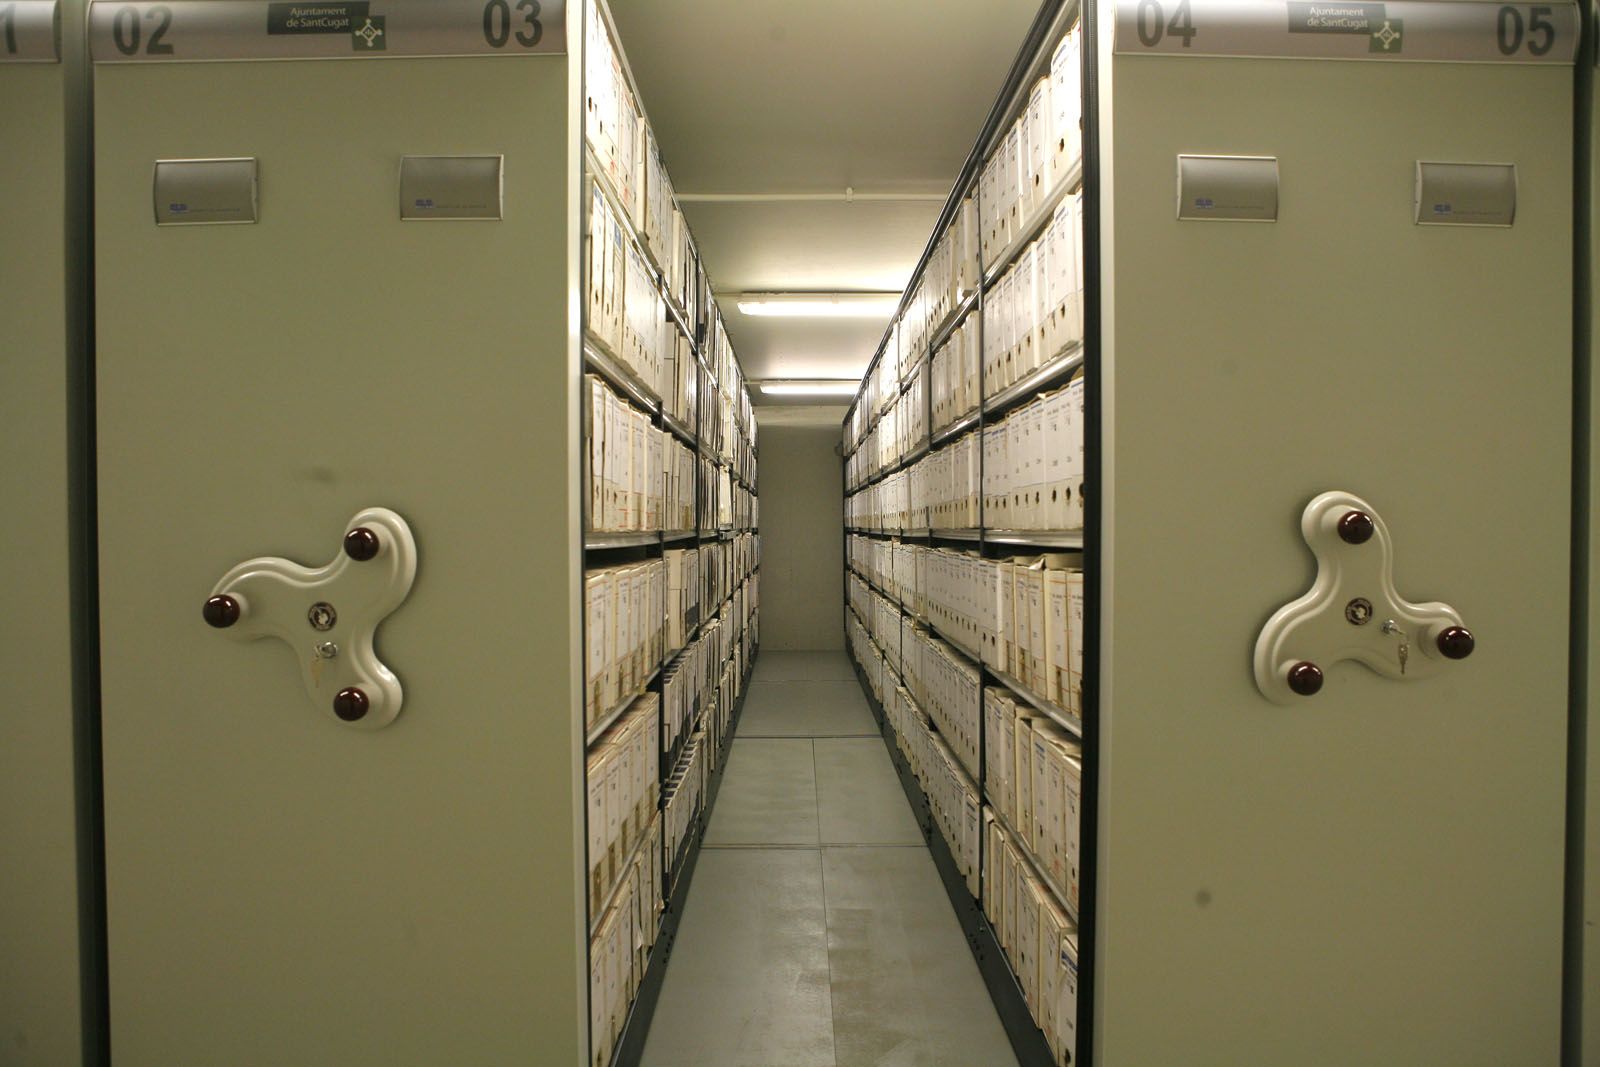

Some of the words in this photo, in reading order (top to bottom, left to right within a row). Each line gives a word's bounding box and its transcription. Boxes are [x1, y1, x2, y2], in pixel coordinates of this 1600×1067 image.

[286, 18, 299, 27] de
[290, 7, 346, 17] Ajuntament
[483, 0, 543, 48] 03
[1137, 0, 1197, 48] 04
[1307, 18, 1319, 27] de
[1309, 7, 1364, 17] Ajuntament
[113, 6, 175, 56] 02
[1497, 6, 1555, 56] 05
